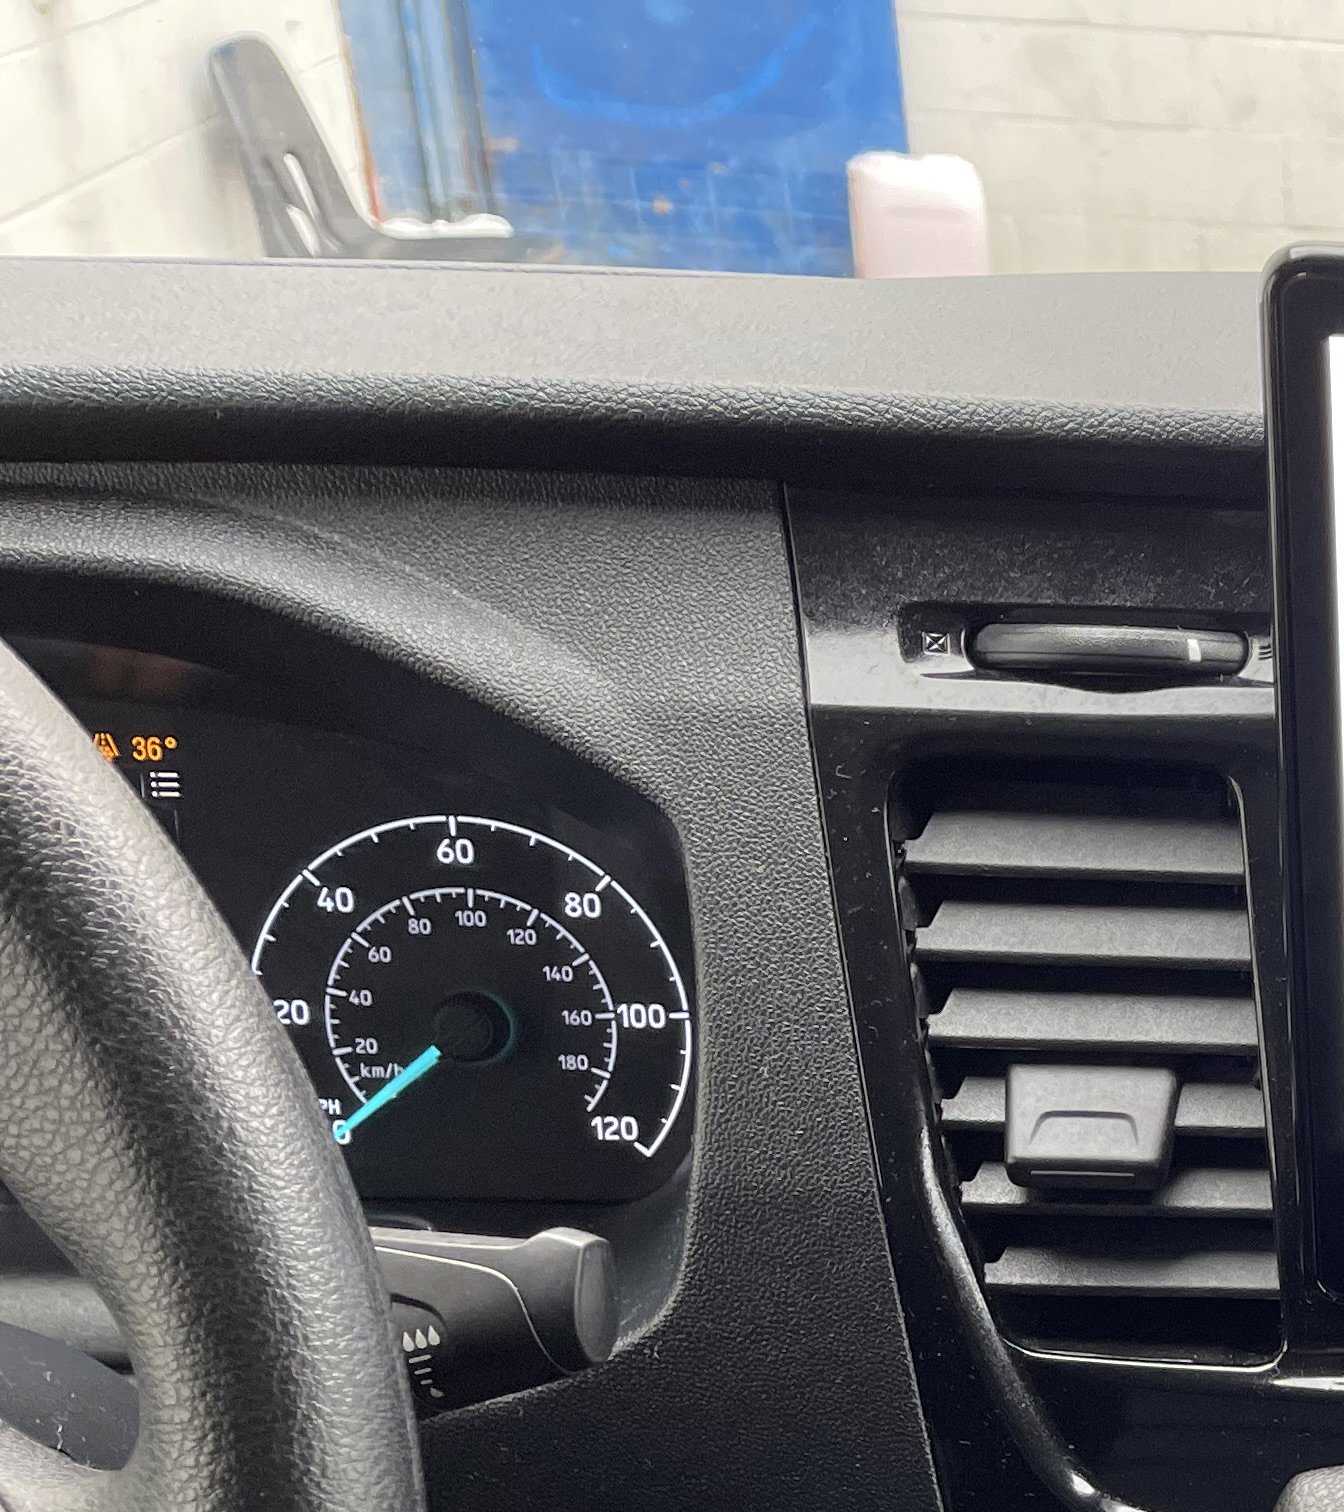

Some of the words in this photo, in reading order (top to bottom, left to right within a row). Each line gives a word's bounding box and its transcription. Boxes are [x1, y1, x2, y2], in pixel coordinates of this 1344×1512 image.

[131, 736, 177, 761] 36°
[436, 838, 474, 865] 60
[317, 888, 355, 913] 40
[564, 894, 602, 919] 80
[407, 917, 432, 935] 80
[454, 910, 487, 927] 100
[506, 928, 537, 946] 120
[367, 945, 392, 963] 60
[542, 966, 573, 983] 140
[348, 989, 373, 1007] 40
[272, 998, 311, 1026] 20
[561, 1009, 593, 1026] 160
[616, 1003, 666, 1029] 100
[354, 1037, 378, 1055] 20
[558, 1054, 589, 1071] 180
[590, 1115, 638, 1142] 120
